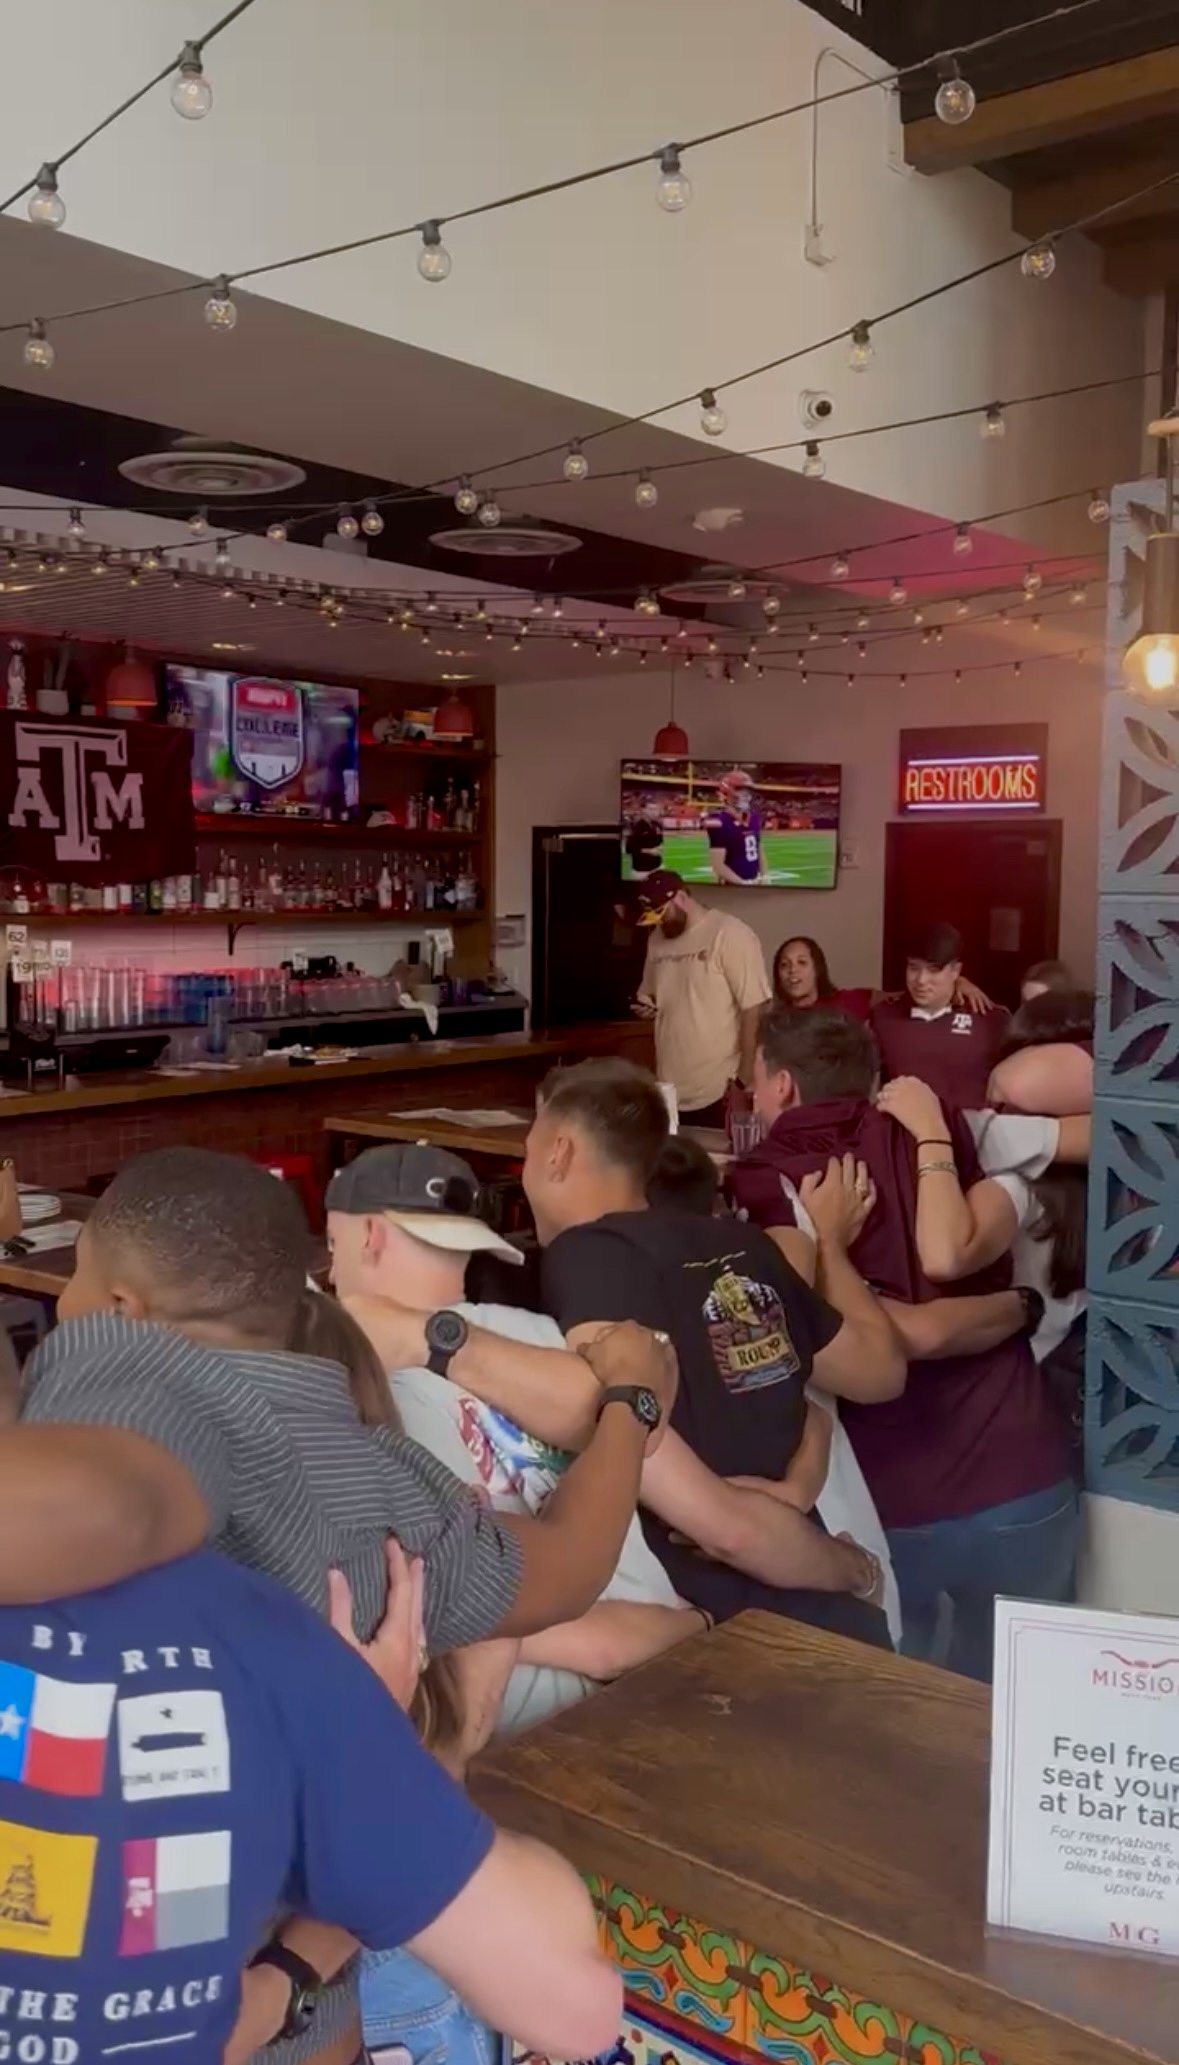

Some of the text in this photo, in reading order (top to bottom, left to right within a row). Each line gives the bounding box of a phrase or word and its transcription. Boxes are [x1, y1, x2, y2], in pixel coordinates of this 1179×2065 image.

[905, 764, 1037, 801] RESTROOMS
[31, 1624, 214, 1674] BY RTH
[1092, 1668, 1179, 1695] MISSIO
[1053, 1735, 1179, 1773] Feel free
[1042, 1766, 1179, 1803] seat your
[1039, 1792, 1179, 1830] at bar tab
[1049, 1824, 1076, 1840] For
[1057, 1844, 1098, 1859] room
[1101, 1849, 1147, 1866] tables
[1151, 1854, 1162, 1868] &
[1063, 1859, 1113, 1878] please
[1116, 1868, 1142, 1881] see
[1147, 1870, 1172, 1885] the
[0, 1975, 223, 2022] THE GRACE
